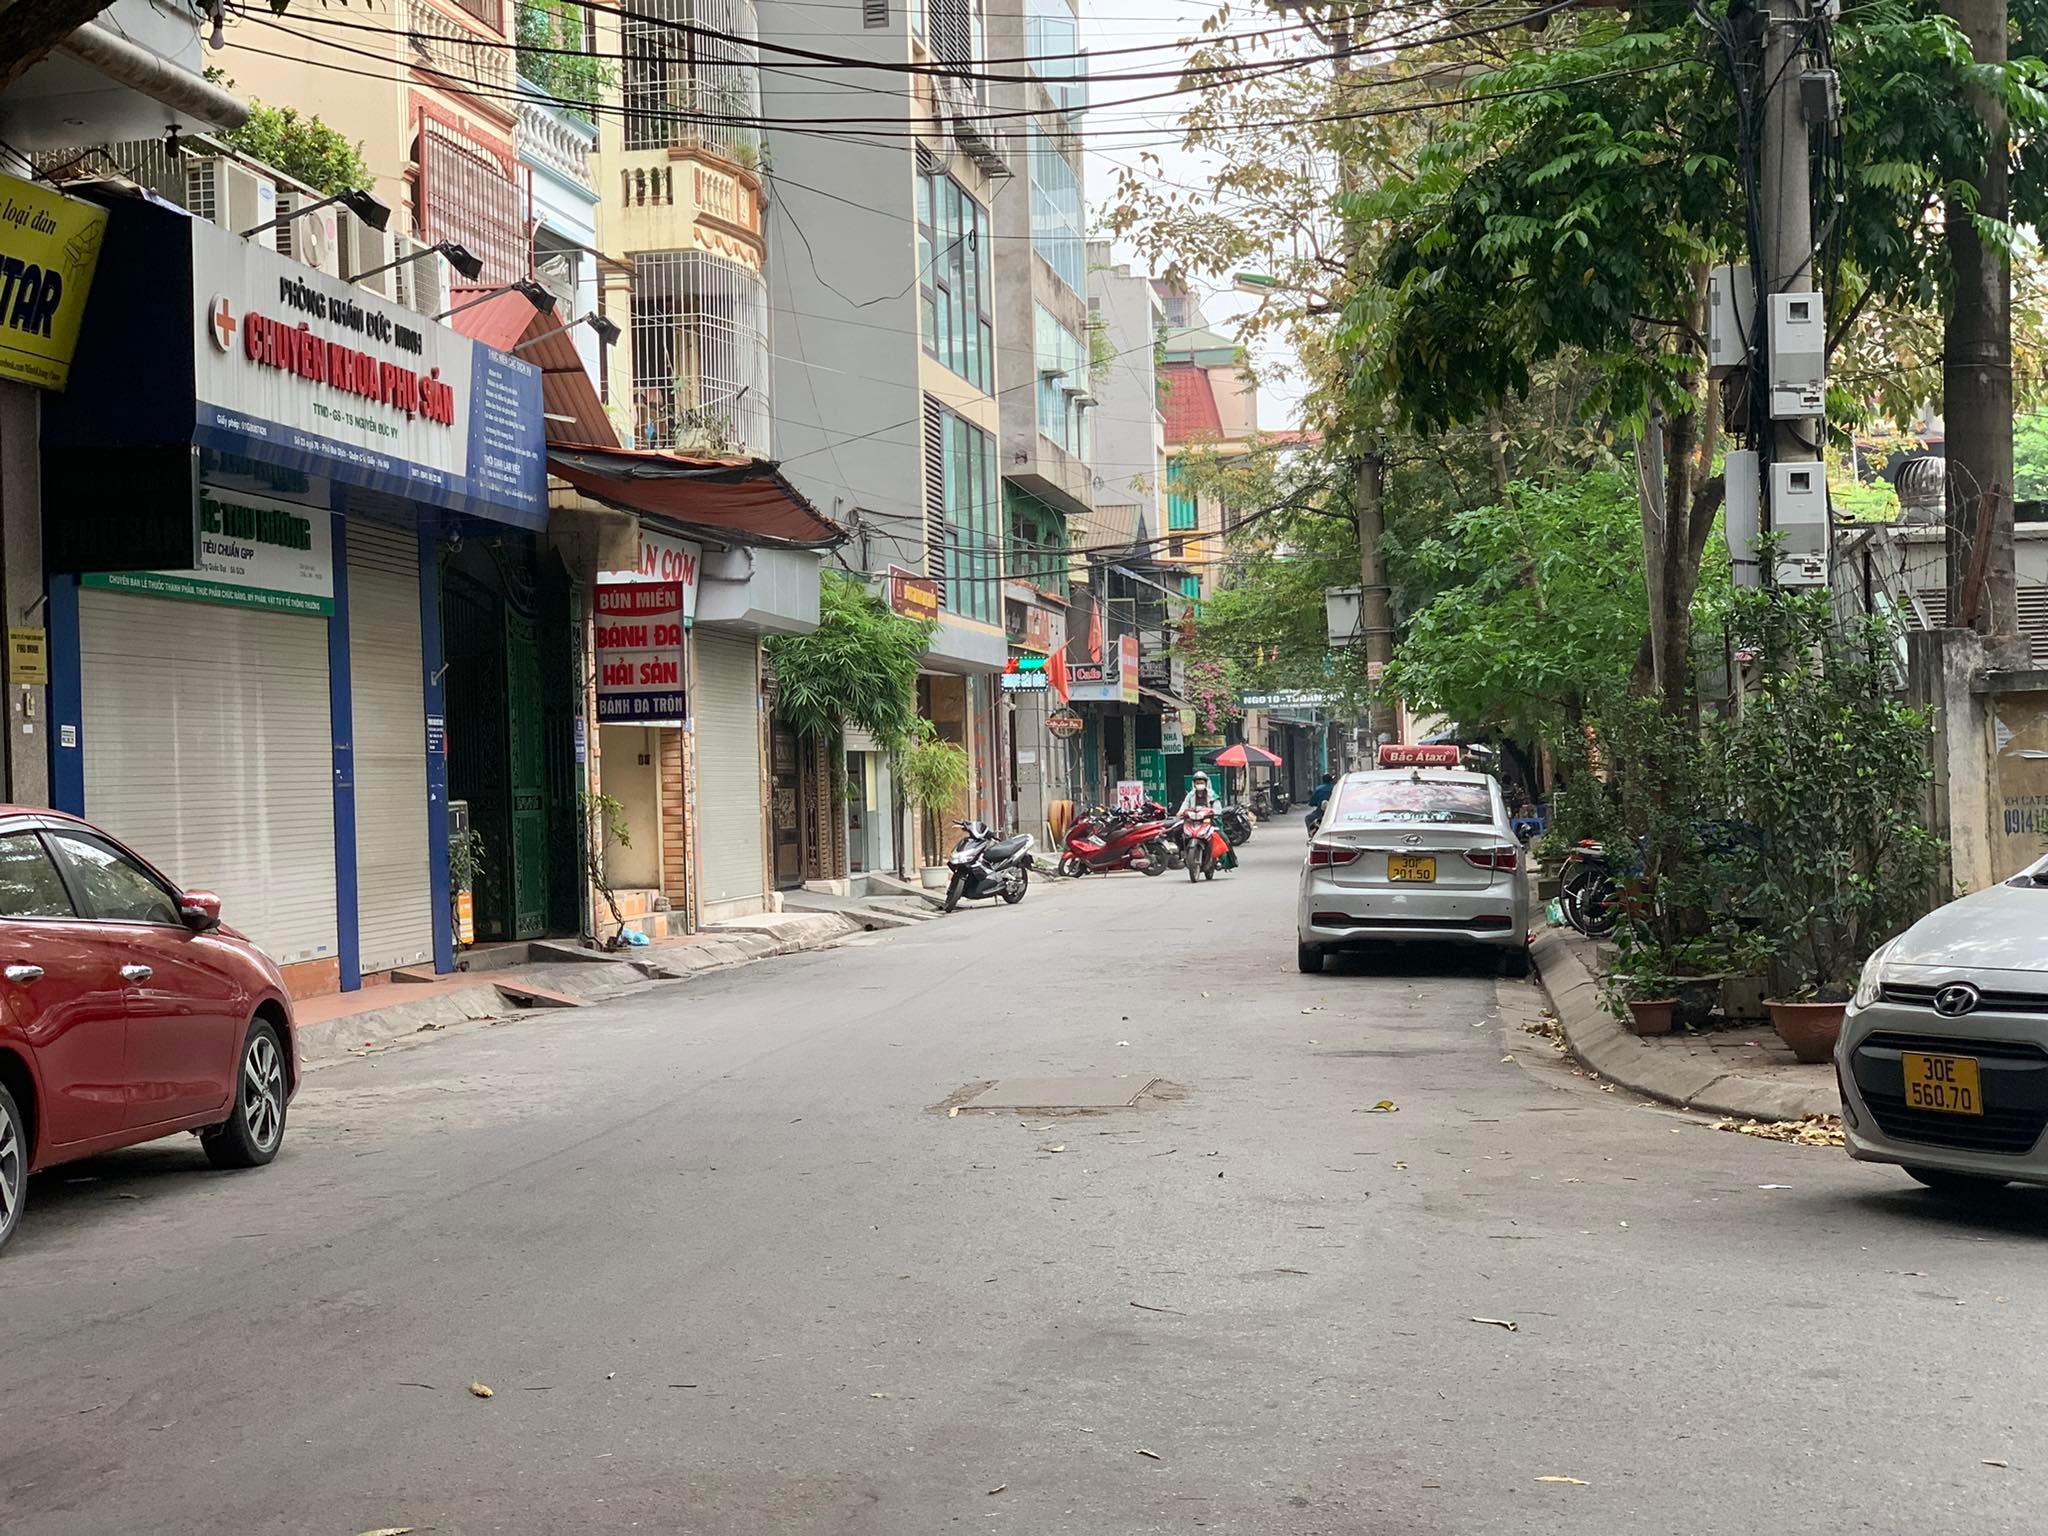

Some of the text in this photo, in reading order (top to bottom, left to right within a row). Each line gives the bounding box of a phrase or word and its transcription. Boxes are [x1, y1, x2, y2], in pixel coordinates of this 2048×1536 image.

[3, 198, 57, 236] loại đàn
[279, 276, 327, 320] PHÒNG
[328, 298, 365, 334] KHÁM
[243, 311, 455, 427] CHUYÊN KHOA PHỤ SẢN
[240, 548, 254, 560] GPP
[661, 547, 696, 586] CƠM
[599, 586, 676, 609] BÚN MIẾN
[597, 622, 681, 649] BÁNH ĐA
[603, 656, 678, 686] HẢI SẢN
[599, 695, 683, 716] BÁNH ĐA TRỘN
[1923, 1057, 1957, 1083] 30E
[1911, 1082, 1972, 1111] 560.70
